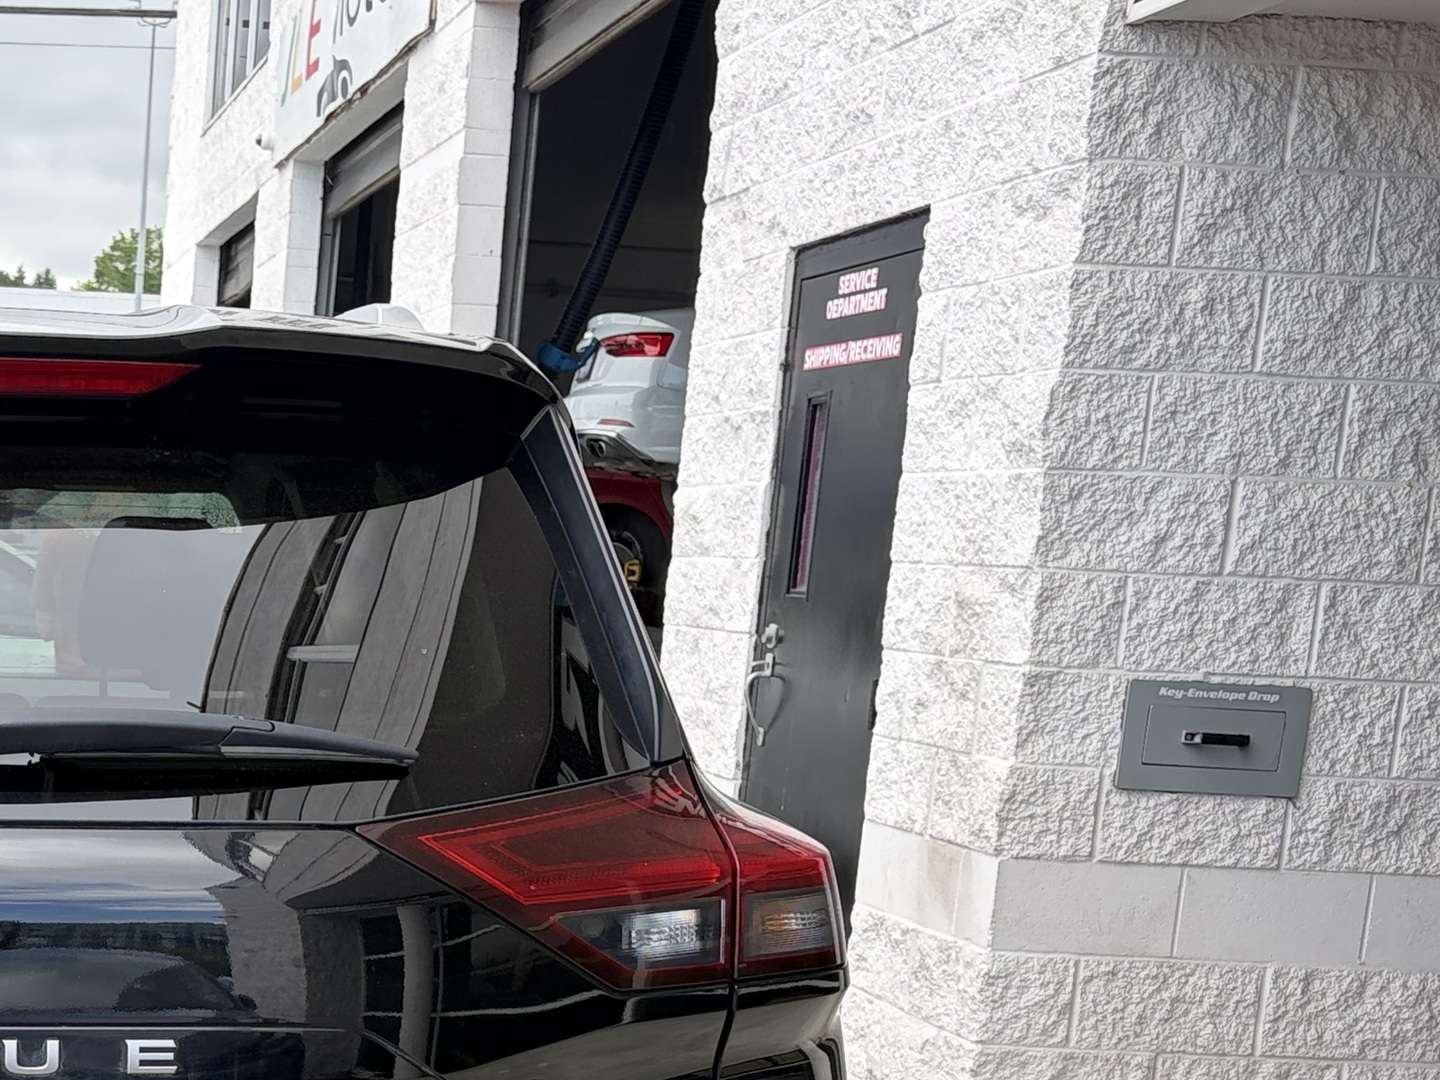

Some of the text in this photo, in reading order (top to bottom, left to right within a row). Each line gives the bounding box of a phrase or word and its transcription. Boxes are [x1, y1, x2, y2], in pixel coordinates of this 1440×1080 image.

[838, 267, 880, 295] SERVICE
[825, 287, 889, 320] DEPARTMENT
[803, 333, 903, 371] SHIPPING/RECEIVING
[1158, 686, 1280, 704] Key-Envelope Drop
